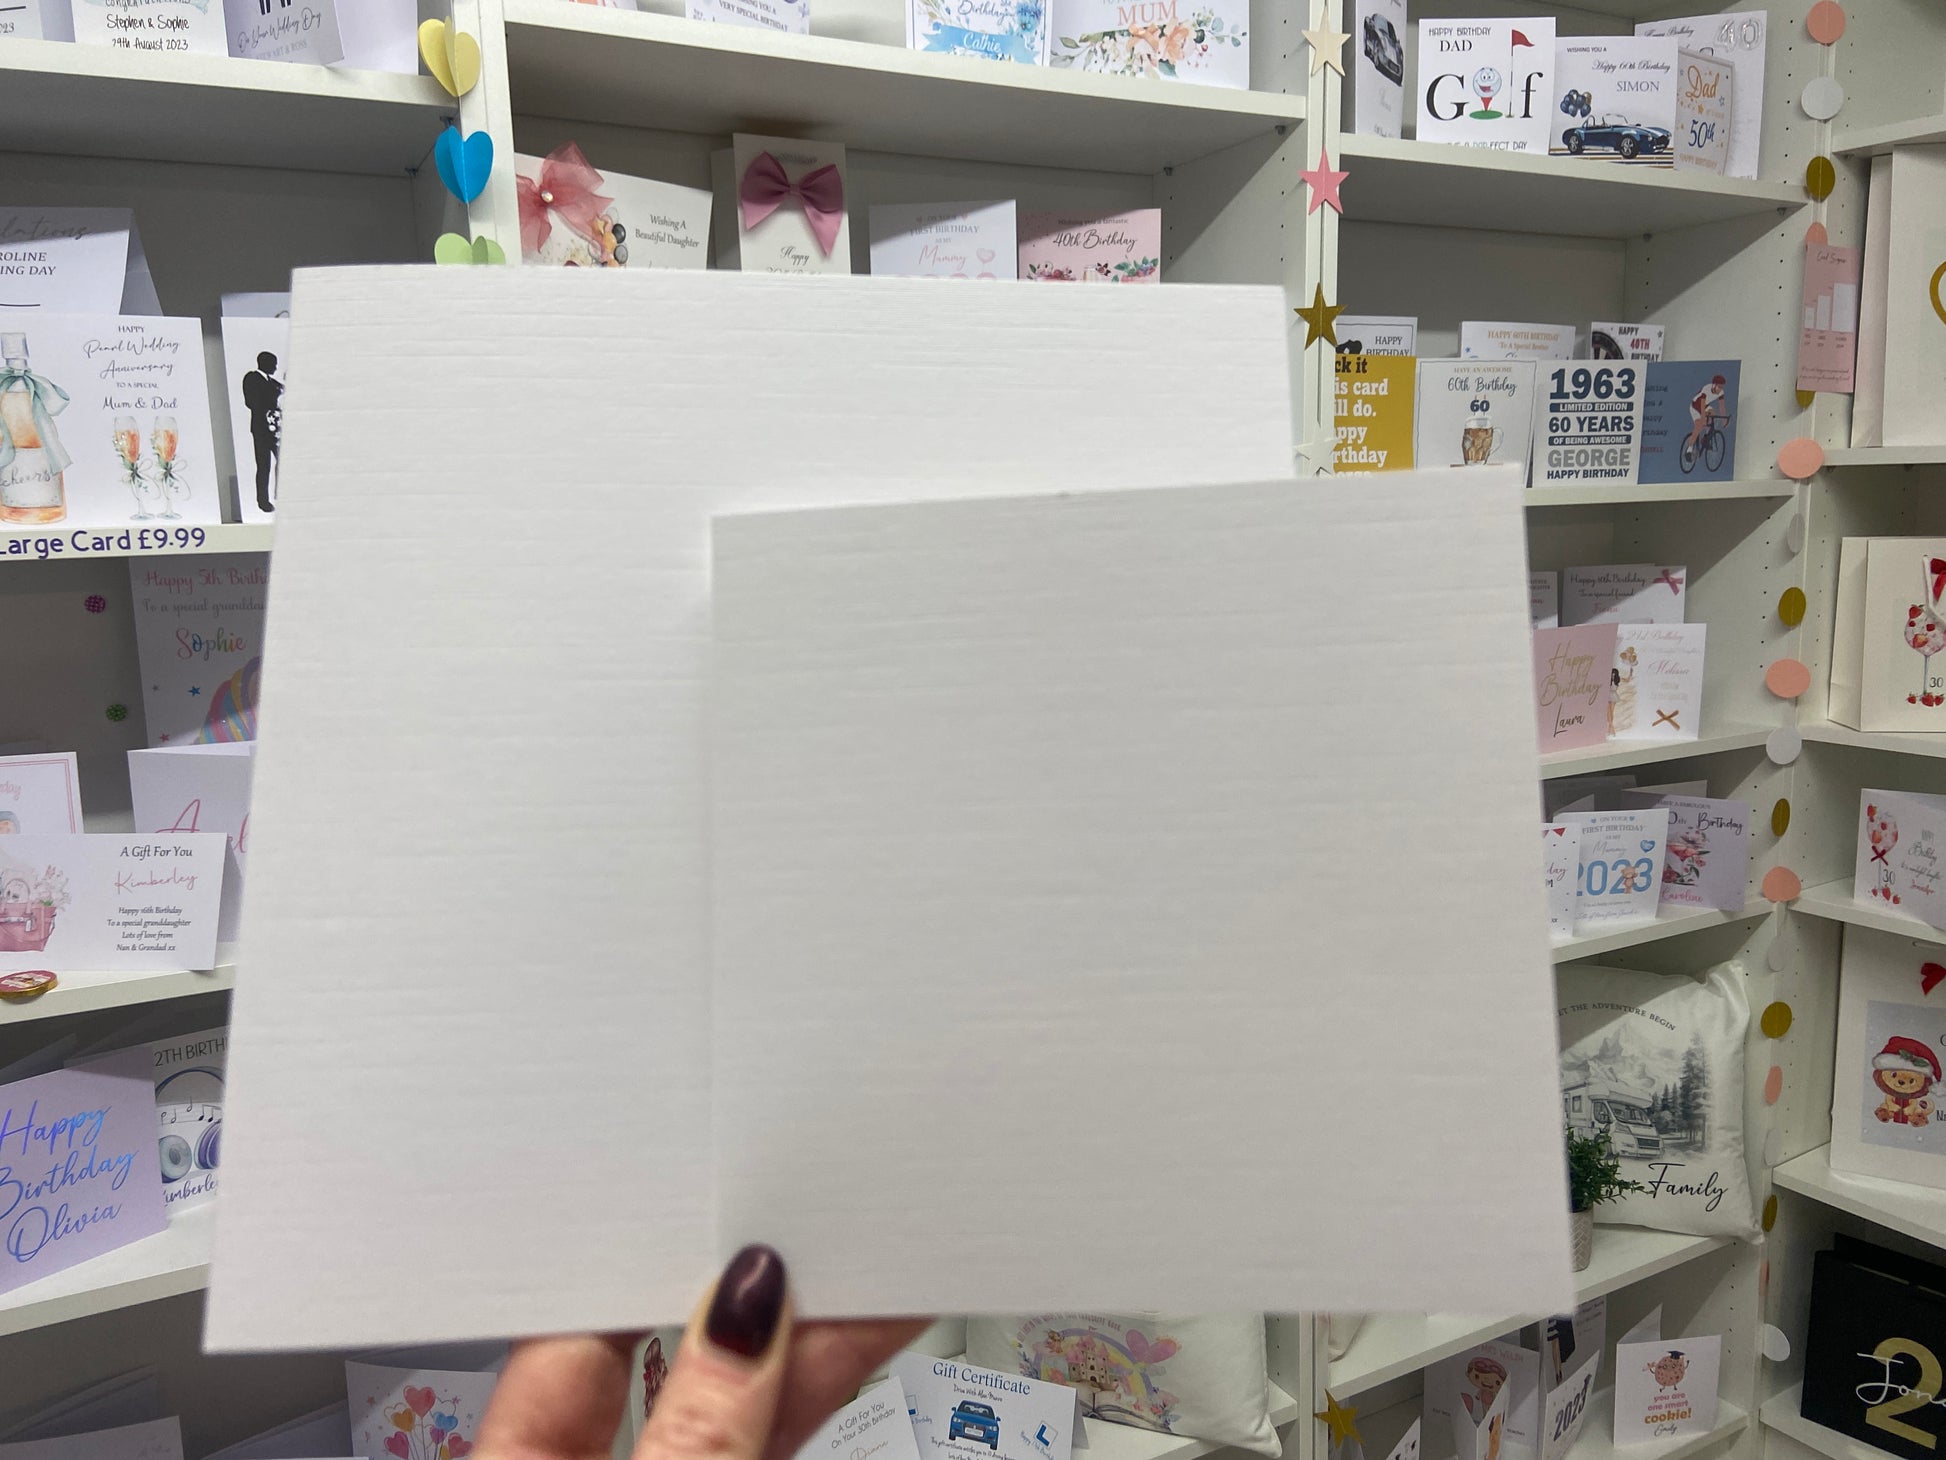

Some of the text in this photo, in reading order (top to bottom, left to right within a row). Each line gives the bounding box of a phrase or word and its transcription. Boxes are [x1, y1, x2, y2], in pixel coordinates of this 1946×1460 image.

[107, 14, 190, 32] Stephen & Sophie
[301, 7, 321, 30] Day
[719, 2, 735, 12] VERY
[736, 7, 760, 20] SPECIAL
[760, 15, 788, 32] BIRTHDAY
[1117, 1, 1179, 27] MUM
[1428, 27, 1491, 36] HAPPY BIRTHDAY
[134, 37, 189, 51] August 2023
[963, 32, 1001, 53] Cathie
[1440, 40, 1473, 52] DAD
[1592, 60, 1671, 74] Happy Birthday
[1616, 81, 1660, 92] SIMON
[1686, 65, 1720, 99] Dad
[1688, 119, 1716, 148] 50th
[1513, 141, 1528, 150] DAY
[650, 214, 686, 231] Wishing A
[935, 224, 980, 234] BIRTHDAY
[635, 228, 700, 249] Beautiful Daughter
[1052, 229, 1138, 253] 40th Birthday
[780, 245, 809, 266] Happy
[29, 265, 57, 276] DAY
[118, 325, 145, 333] HAPPY
[1488, 330, 1560, 341] HAPPY BIRTHDAY
[1618, 326, 1639, 336] HAPPY
[83, 336, 180, 359] Pearl Wedding
[1375, 336, 1403, 346] HAPPY
[1630, 338, 1650, 350] 40TH
[1366, 348, 1410, 356] BIRTHDAY
[1630, 352, 1660, 363] BIRTHDAY
[99, 359, 174, 380] Anniversary
[1355, 357, 1368, 374] it
[1353, 378, 1389, 396] card
[1447, 377, 1518, 398] 60th Birthday
[1549, 368, 1636, 400] 1963
[102, 397, 178, 410] Mum & Dad
[1353, 399, 1377, 417] do.
[1470, 400, 1490, 413] 60
[1560, 403, 1628, 411] LIMITED EDITION
[1549, 416, 1571, 433] 60
[1576, 415, 1635, 433] YEARS
[1589, 436, 1627, 444] AWESOME
[1547, 448, 1632, 468] GEORGE
[1547, 468, 1630, 480] HAPPY BIRTHDAY
[71, 527, 206, 551] Card £9.99
[142, 569, 193, 595] Happy
[198, 568, 221, 586] 5th
[1612, 572, 1646, 587] Birthday
[143, 599, 157, 611] To
[172, 600, 208, 618] special
[176, 627, 247, 662] Sophie
[1548, 640, 1596, 676] Happy
[1538, 673, 1603, 708] Birthday
[1929, 677, 1944, 688] 30
[1553, 702, 1586, 738] Laura
[1582, 825, 1645, 835] FIRST BIRTHDAY
[1697, 812, 1743, 836] Birthday
[120, 845, 193, 861] A Gift For You
[114, 867, 198, 895] Kimberley
[1882, 869, 1896, 885] 30
[1662, 887, 1704, 903] Caroline
[118, 906, 182, 917] Happy Birthday
[107, 919, 115, 927] To
[121, 918, 143, 929] special
[143, 918, 192, 929] granddaughter
[121, 930, 173, 942] Lots of love from
[138, 943, 167, 951] Grandad
[1570, 1002, 1676, 1031] THE ADVENTURE BEGIN
[0, 1100, 112, 1156] Happy
[0, 1145, 139, 1221] Birthday
[1647, 1162, 1729, 1212] Family
[7, 1202, 122, 1263] Olivia
[933, 1362, 1031, 1396] Gift Certificate
[1653, 1395, 1670, 1403] you
[1865, 1337, 1944, 1450] 2
[1553, 1384, 1590, 1443] 2023
[1664, 1400, 1688, 1410] smart
[838, 1402, 885, 1433] A Gift For You
[1644, 1408, 1692, 1424] cookie!
[831, 1407, 896, 1449] On Your 30th Birthday
